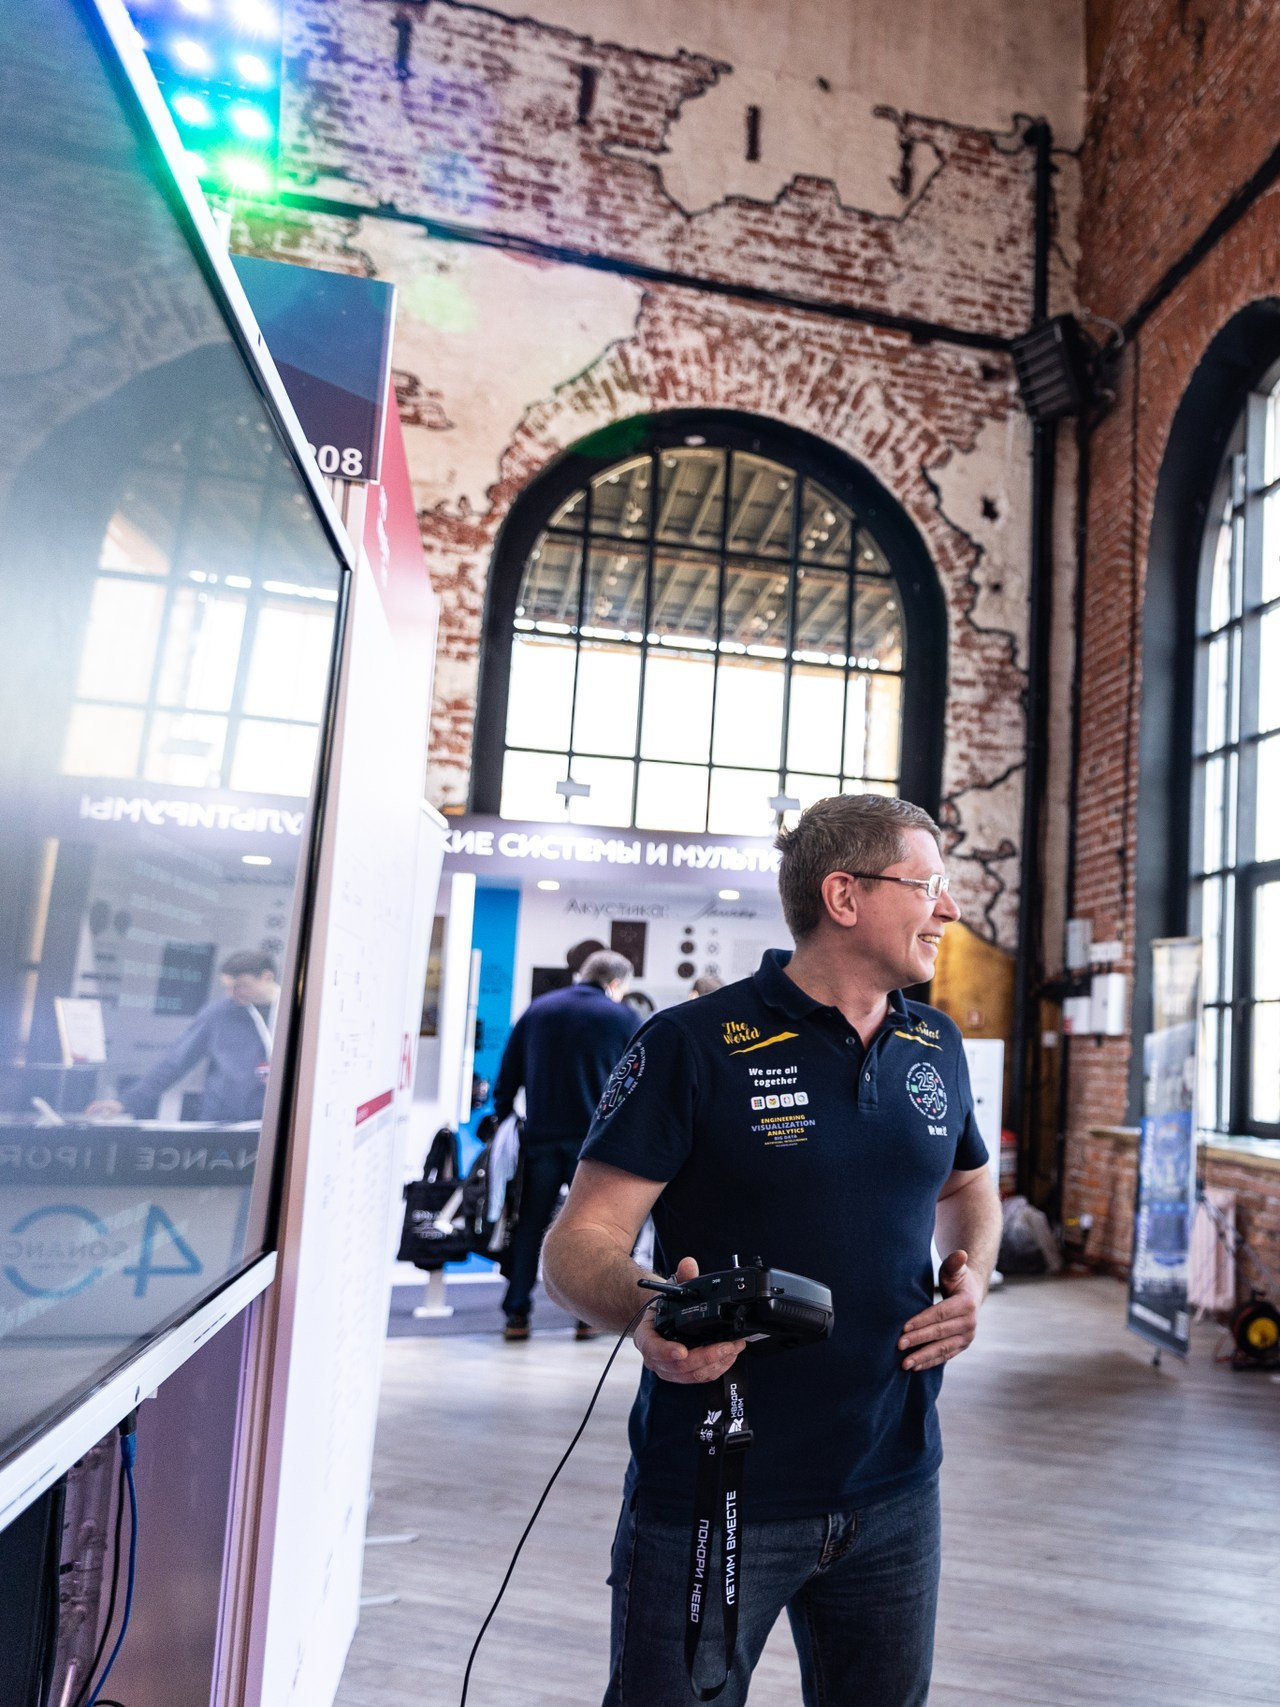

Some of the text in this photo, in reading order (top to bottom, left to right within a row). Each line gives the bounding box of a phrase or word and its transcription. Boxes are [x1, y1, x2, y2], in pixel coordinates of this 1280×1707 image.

[497, 832, 641, 866] СИСТЕМЫ
[645, 842, 668, 867] И
[722, 1021, 747, 1034] The
[723, 1027, 760, 1045] World
[749, 1066, 798, 1076] We are all
[754, 1077, 797, 1088] together
[915, 1071, 938, 1092] 25
[922, 1092, 941, 1111] +1
[751, 1119, 816, 1133] VISUALIZATION
[760, 1114, 806, 1124] ENGINEERING
[767, 1127, 805, 1137] ANALYTICS
[726, 1490, 737, 1605] ЛЕТИМ ВМЕСТЕ
[691, 1519, 710, 1623] ПОКОРИ НЕБО
